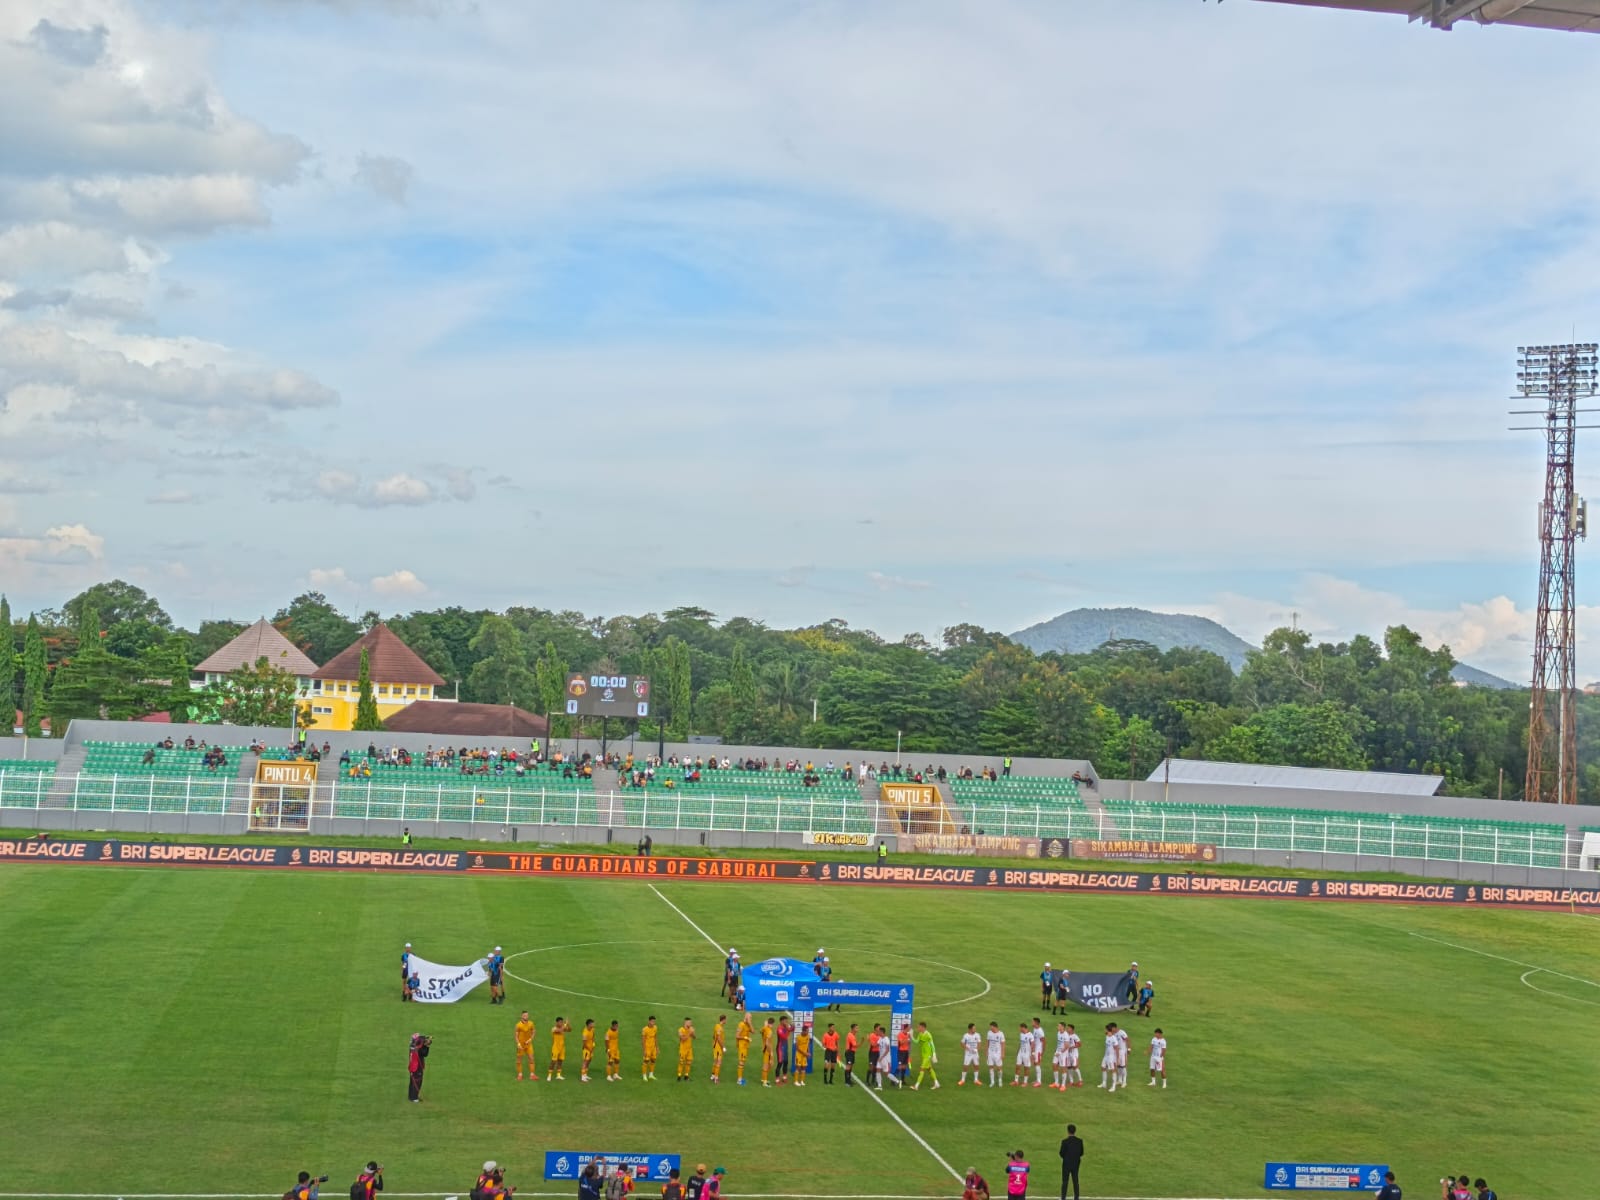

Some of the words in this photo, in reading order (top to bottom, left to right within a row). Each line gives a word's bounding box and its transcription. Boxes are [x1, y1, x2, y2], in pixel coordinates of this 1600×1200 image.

[264, 767, 299, 782] PINTU
[303, 768, 311, 782] 4
[888, 789, 920, 803] PINTU
[923, 790, 931, 804] 5
[120, 845, 146, 860] BRI
[1152, 842, 1197, 854] LAMPUNG
[309, 849, 333, 864] BRI
[509, 855, 542, 870] THE
[552, 857, 657, 873] GUARDIANS
[667, 860, 688, 875] OF
[697, 861, 776, 877] SABURAI
[838, 865, 860, 879] BRI
[1004, 871, 1026, 884] BRI
[1167, 876, 1189, 890] BRI
[1326, 882, 1347, 895] BRI
[1482, 887, 1503, 900] BRI
[817, 988, 831, 996] BRI
[1083, 984, 1102, 997] NO
